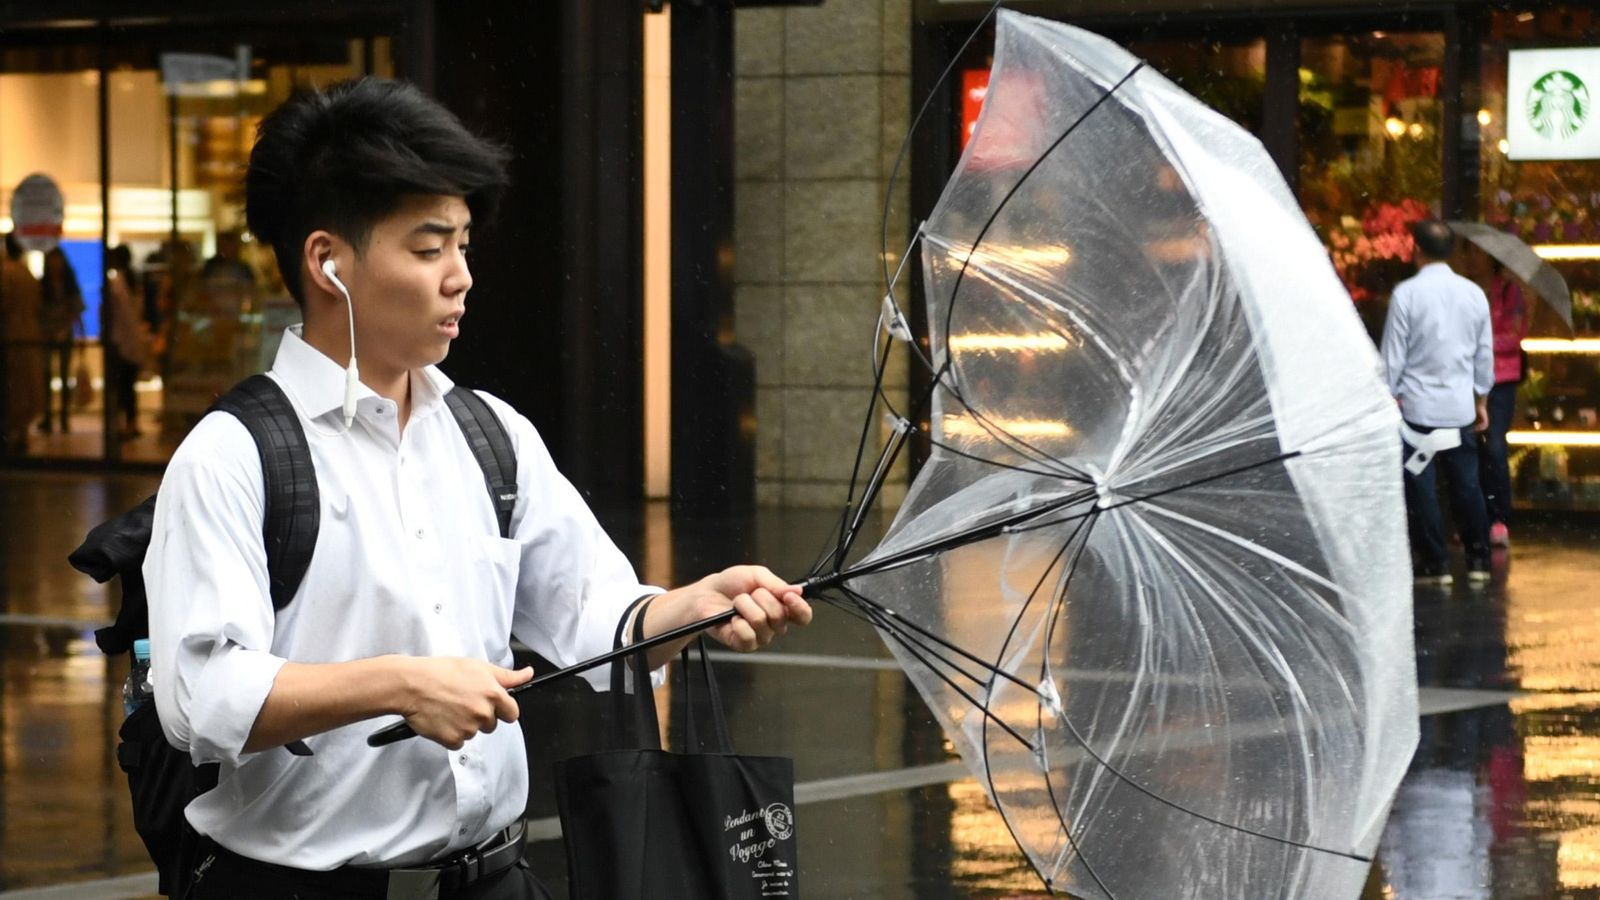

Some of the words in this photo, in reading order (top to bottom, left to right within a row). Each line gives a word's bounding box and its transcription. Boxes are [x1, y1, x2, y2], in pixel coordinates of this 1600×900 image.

[724, 808, 766, 831] Pendant
[740, 828, 754, 841] un
[729, 838, 776, 863] Voyage
